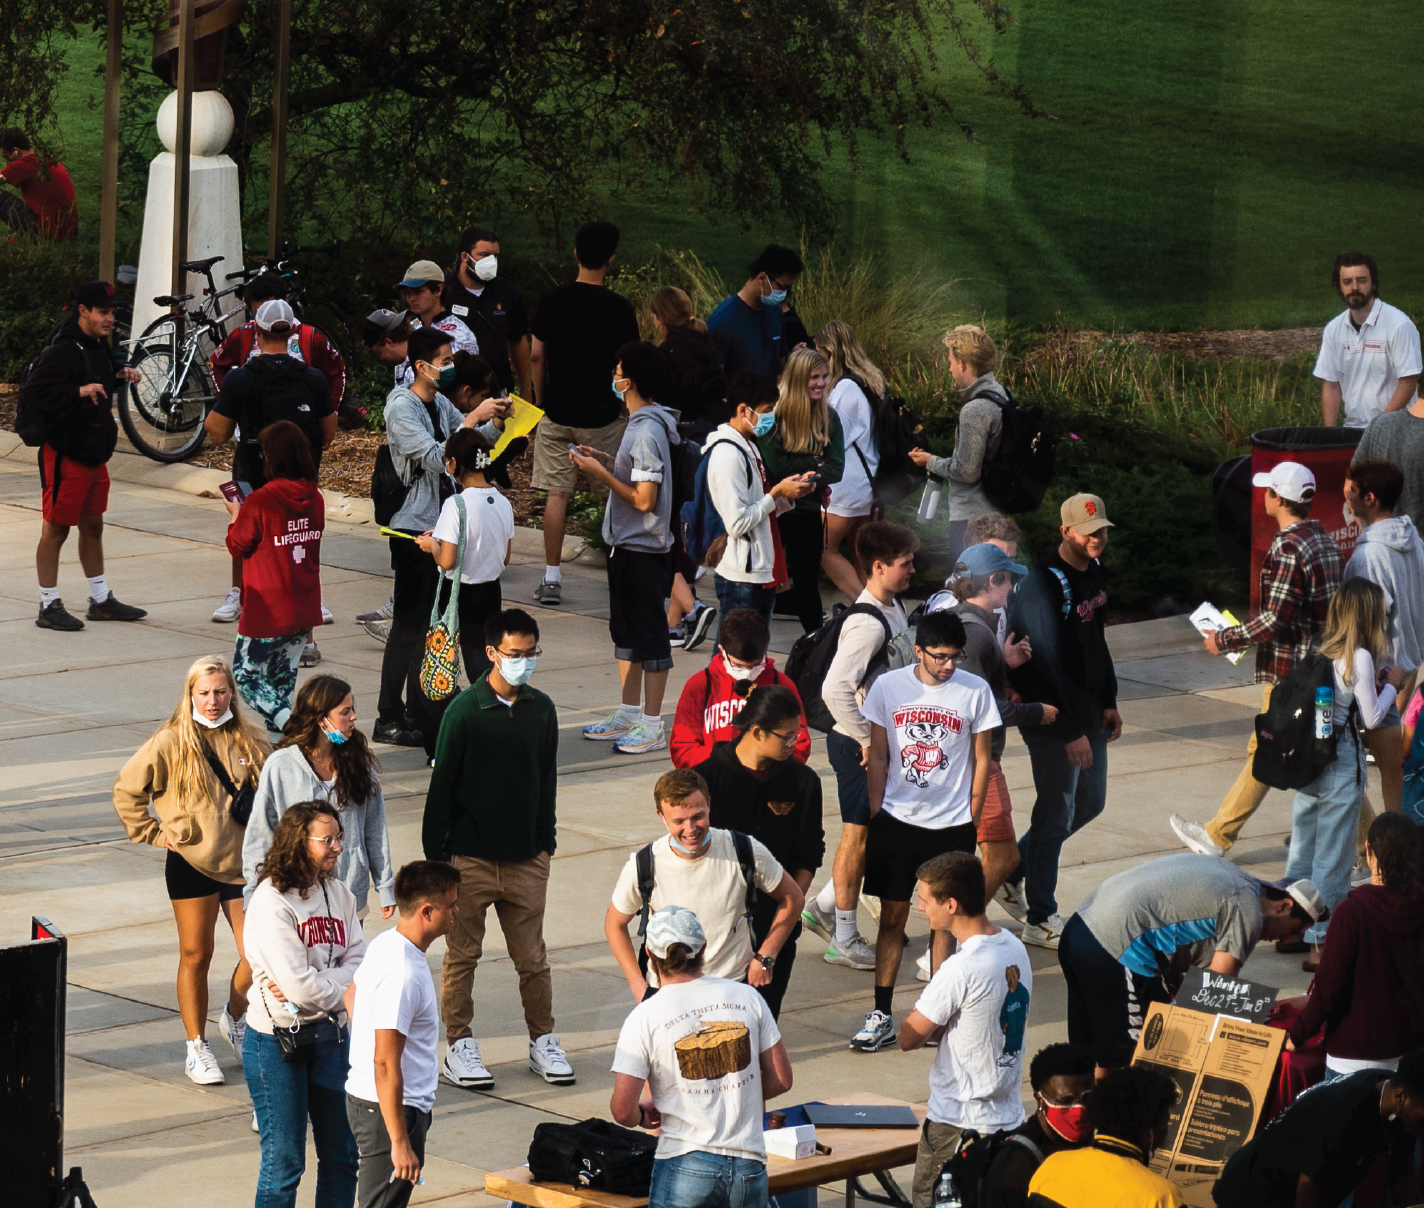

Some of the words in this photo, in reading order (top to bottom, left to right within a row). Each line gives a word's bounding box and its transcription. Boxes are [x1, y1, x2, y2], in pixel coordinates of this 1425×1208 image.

[287, 518, 309, 532] ELITE
[274, 530, 320, 547] LIFEGUARD
[895, 710, 962, 732] WISCONSIN
[664, 1013, 691, 1030] DELTA
[691, 1003, 720, 1016] THETA
[722, 1002, 747, 1012] SIGMA
